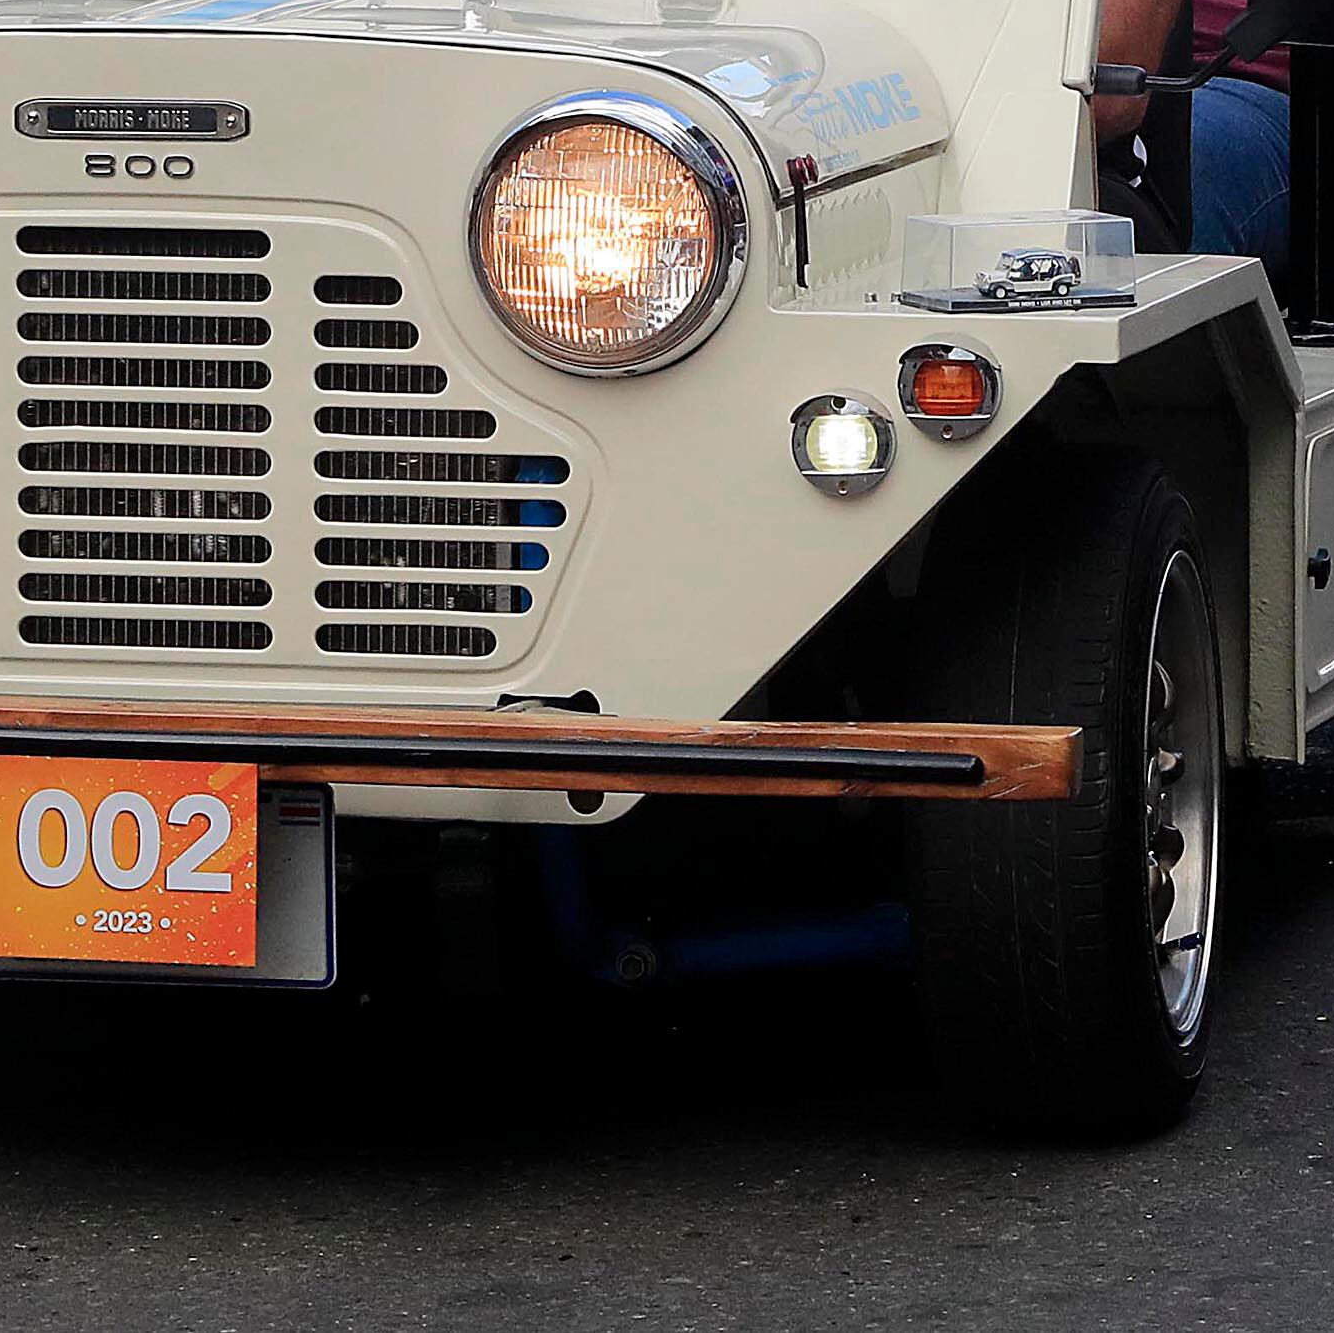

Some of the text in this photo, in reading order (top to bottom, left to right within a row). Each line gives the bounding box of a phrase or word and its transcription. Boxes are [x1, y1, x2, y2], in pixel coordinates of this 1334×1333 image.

[75, 109, 190, 129] MORRIS MOKE
[84, 154, 195, 180] 800
[18, 788, 233, 893] 002
[93, 910, 153, 933] 2023
